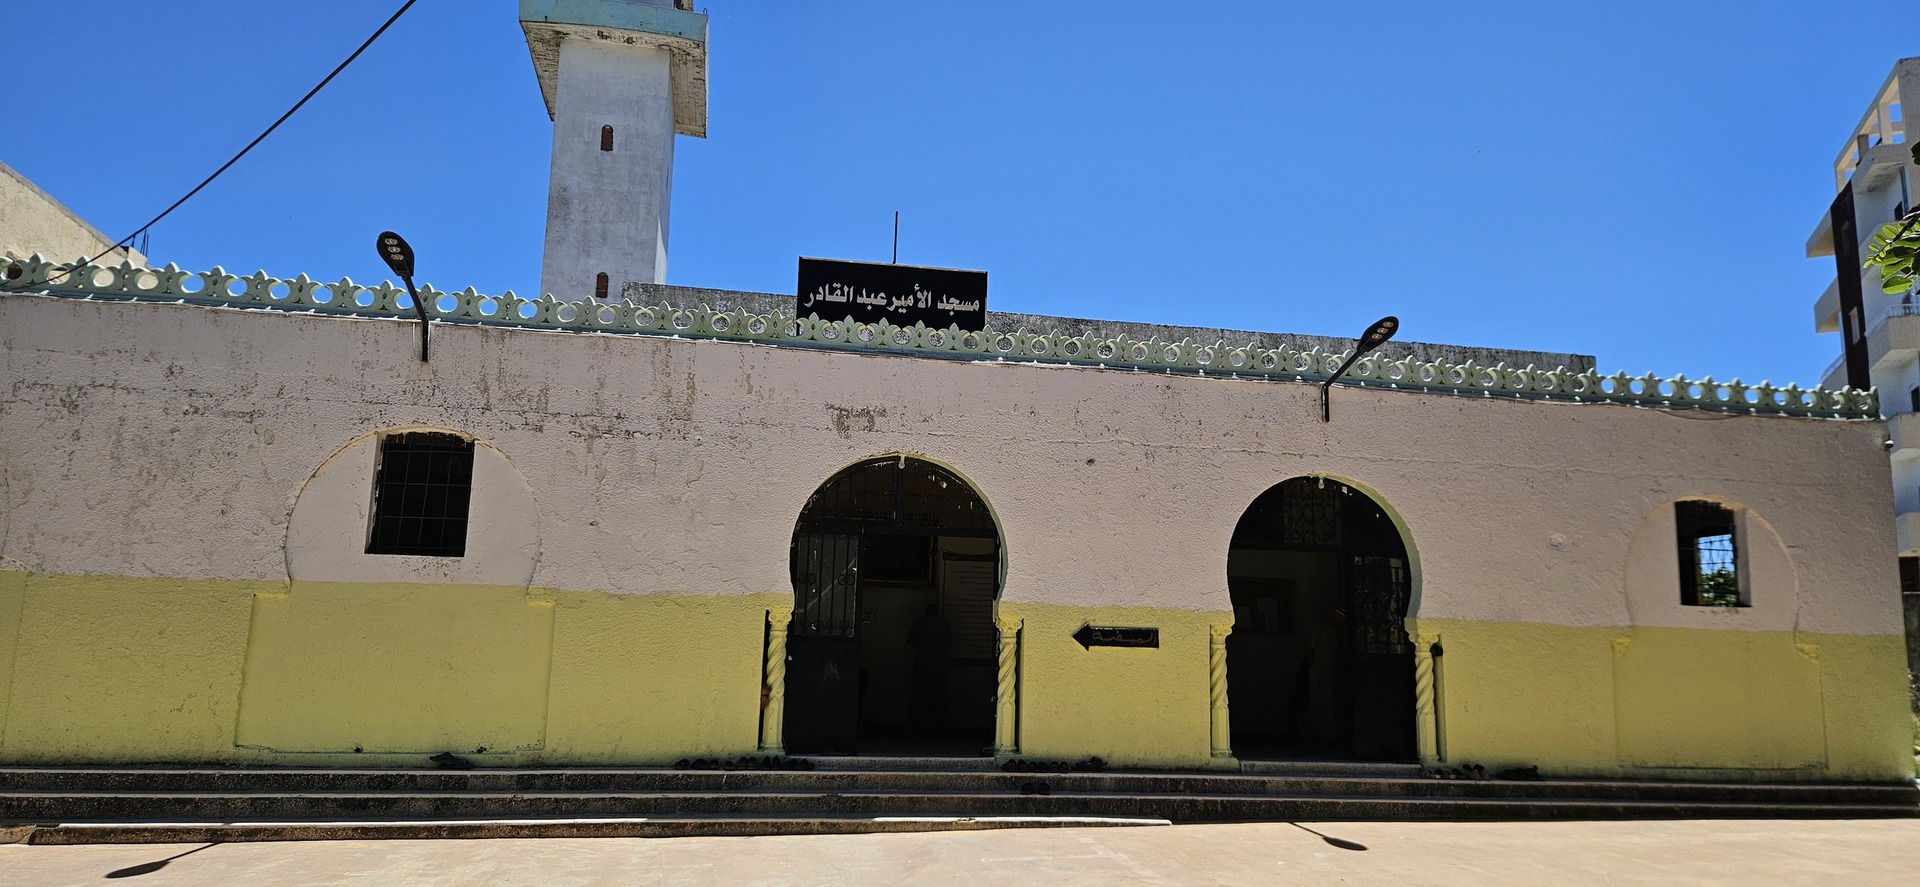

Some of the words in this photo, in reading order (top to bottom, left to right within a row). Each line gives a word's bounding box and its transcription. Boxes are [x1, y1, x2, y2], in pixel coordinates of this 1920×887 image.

[803, 282, 854, 308] القادر
[856, 287, 888, 310] عبد
[886, 283, 932, 314] الأمير
[937, 293, 980, 316] مسجد
